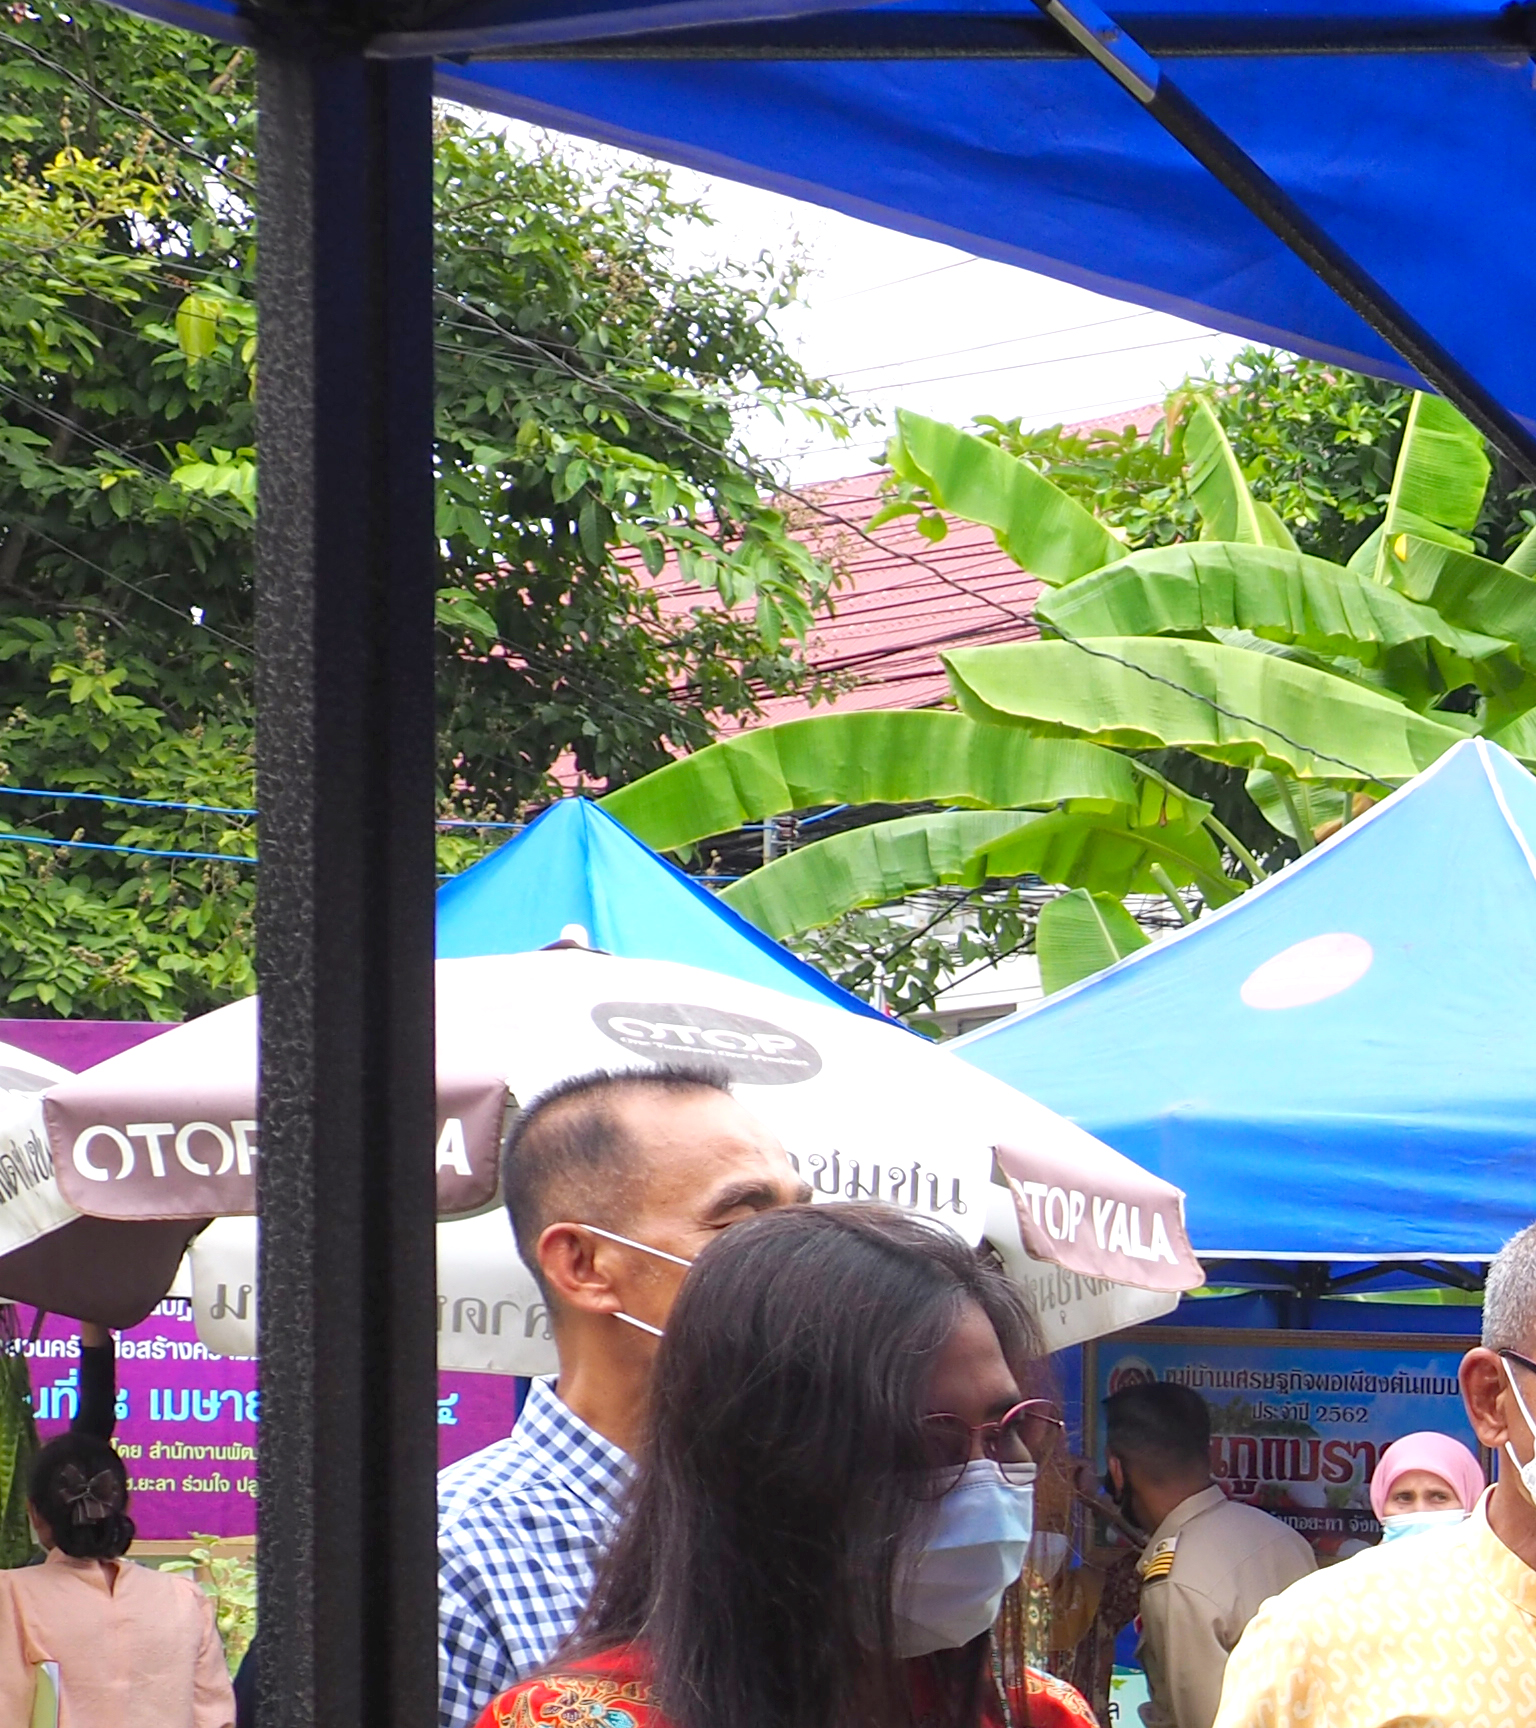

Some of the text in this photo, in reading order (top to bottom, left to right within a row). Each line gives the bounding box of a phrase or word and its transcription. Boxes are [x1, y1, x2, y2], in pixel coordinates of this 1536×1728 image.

[608, 1017, 797, 1054] OTOP
[1092, 1196, 1180, 1265] YALA
[1315, 1406, 1369, 1424] 2562
[182, 1472, 231, 1493] ร่วมใจ
